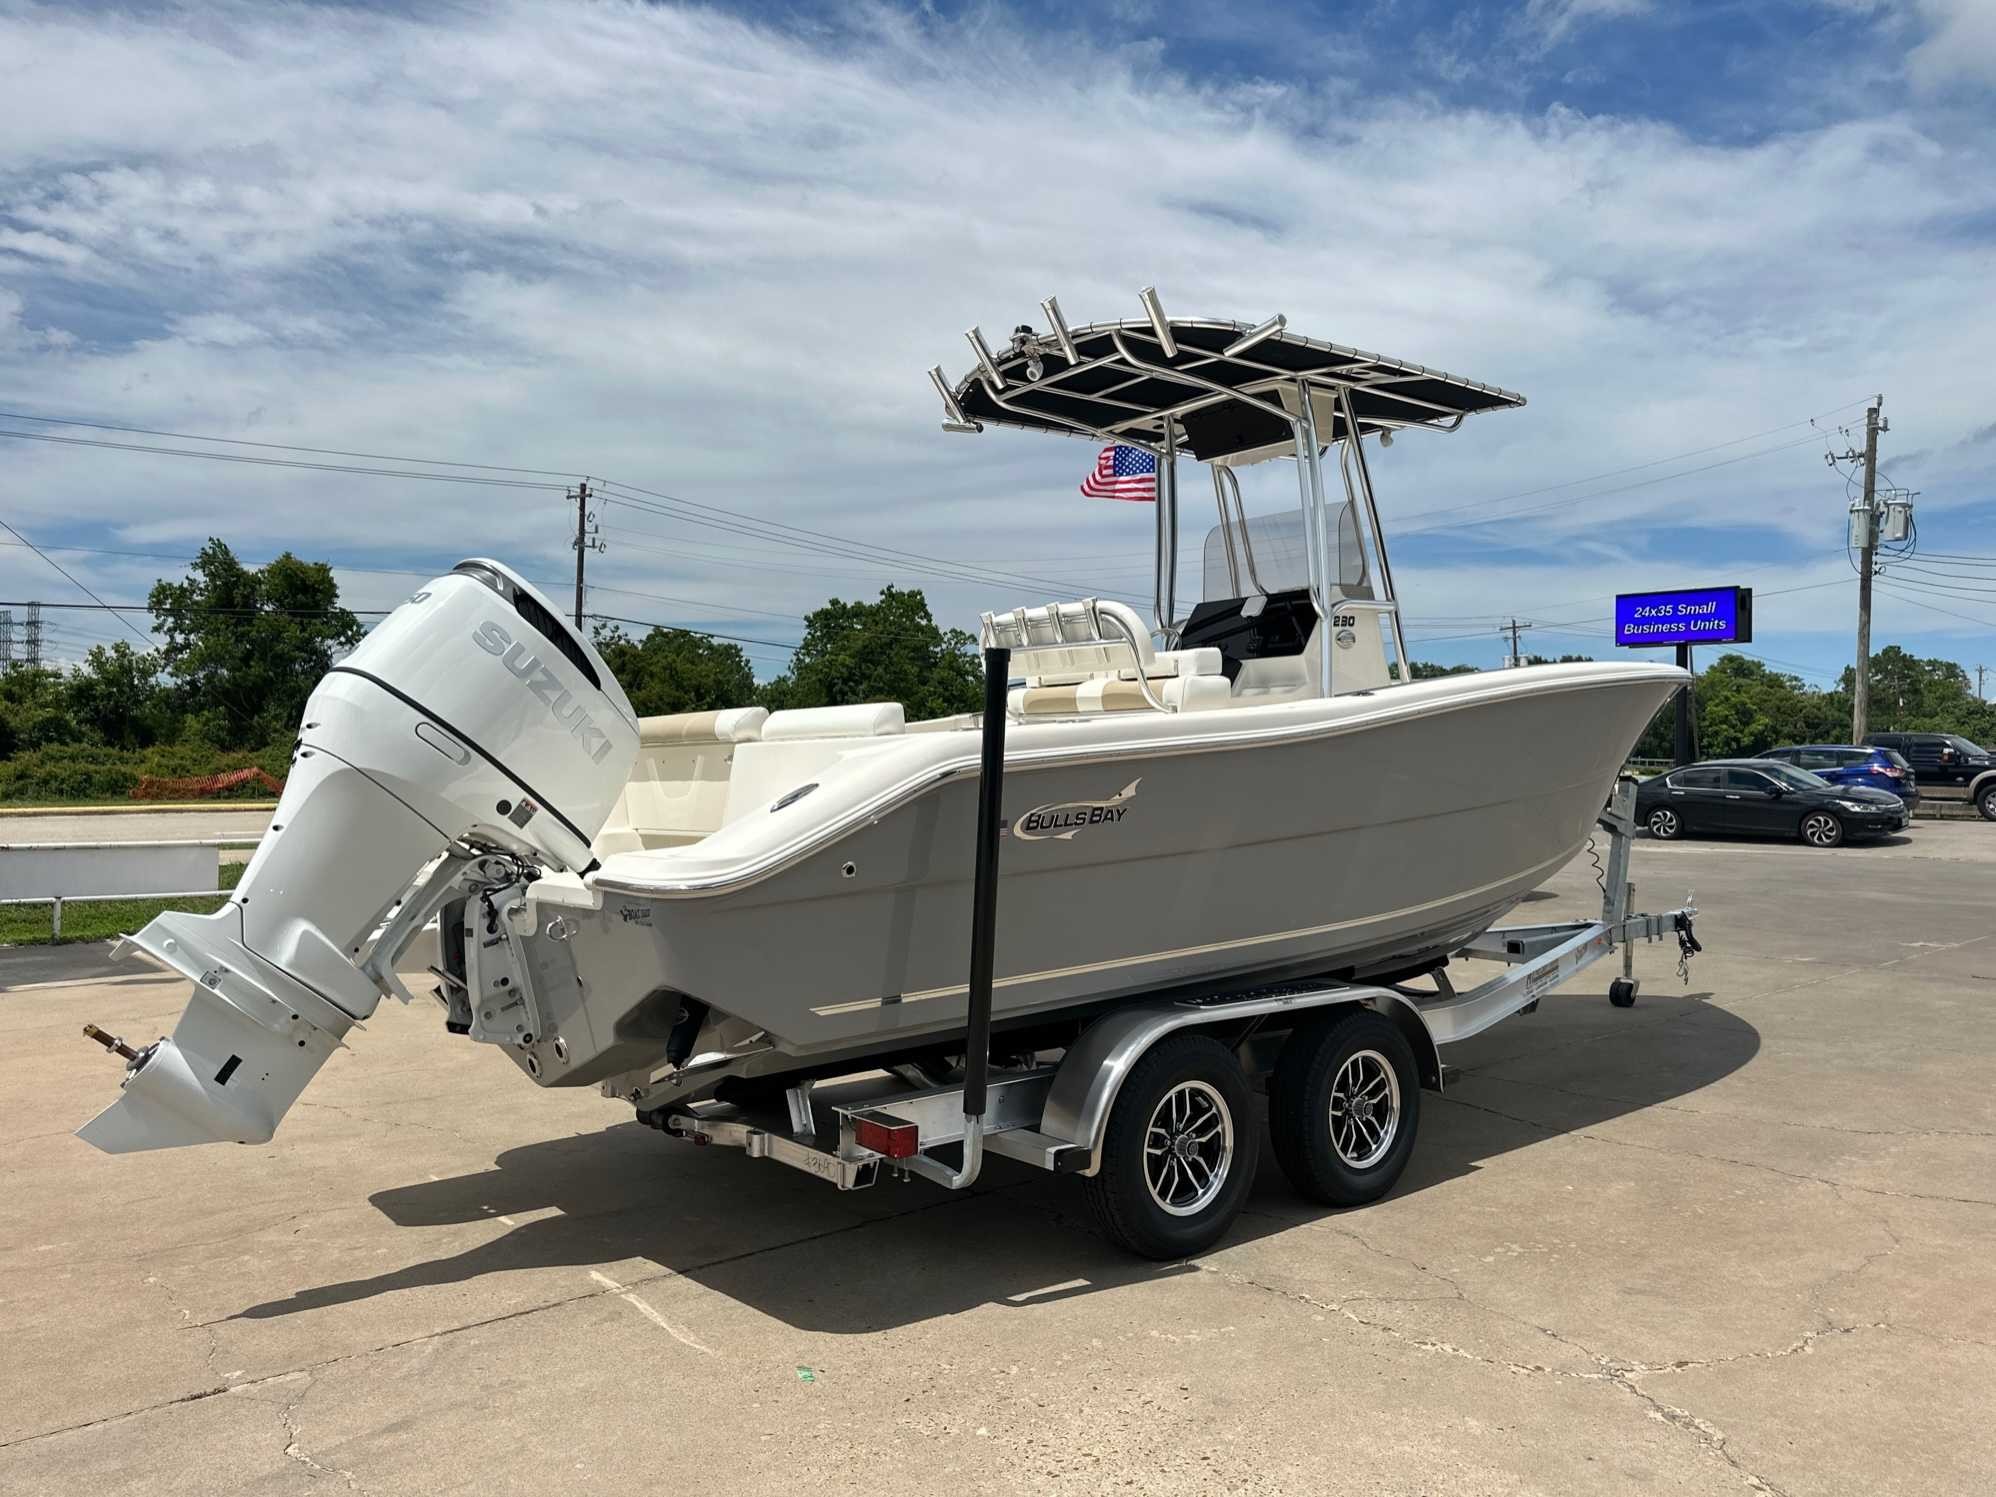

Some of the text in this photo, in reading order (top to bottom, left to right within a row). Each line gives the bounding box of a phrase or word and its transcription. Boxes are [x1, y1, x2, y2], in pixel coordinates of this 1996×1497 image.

[1634, 601, 1717, 618] 24x35 Small
[1624, 618, 1727, 635] Business Units
[471, 620, 613, 766] SUZUKI
[1026, 806, 1127, 831] BULLS BAY
